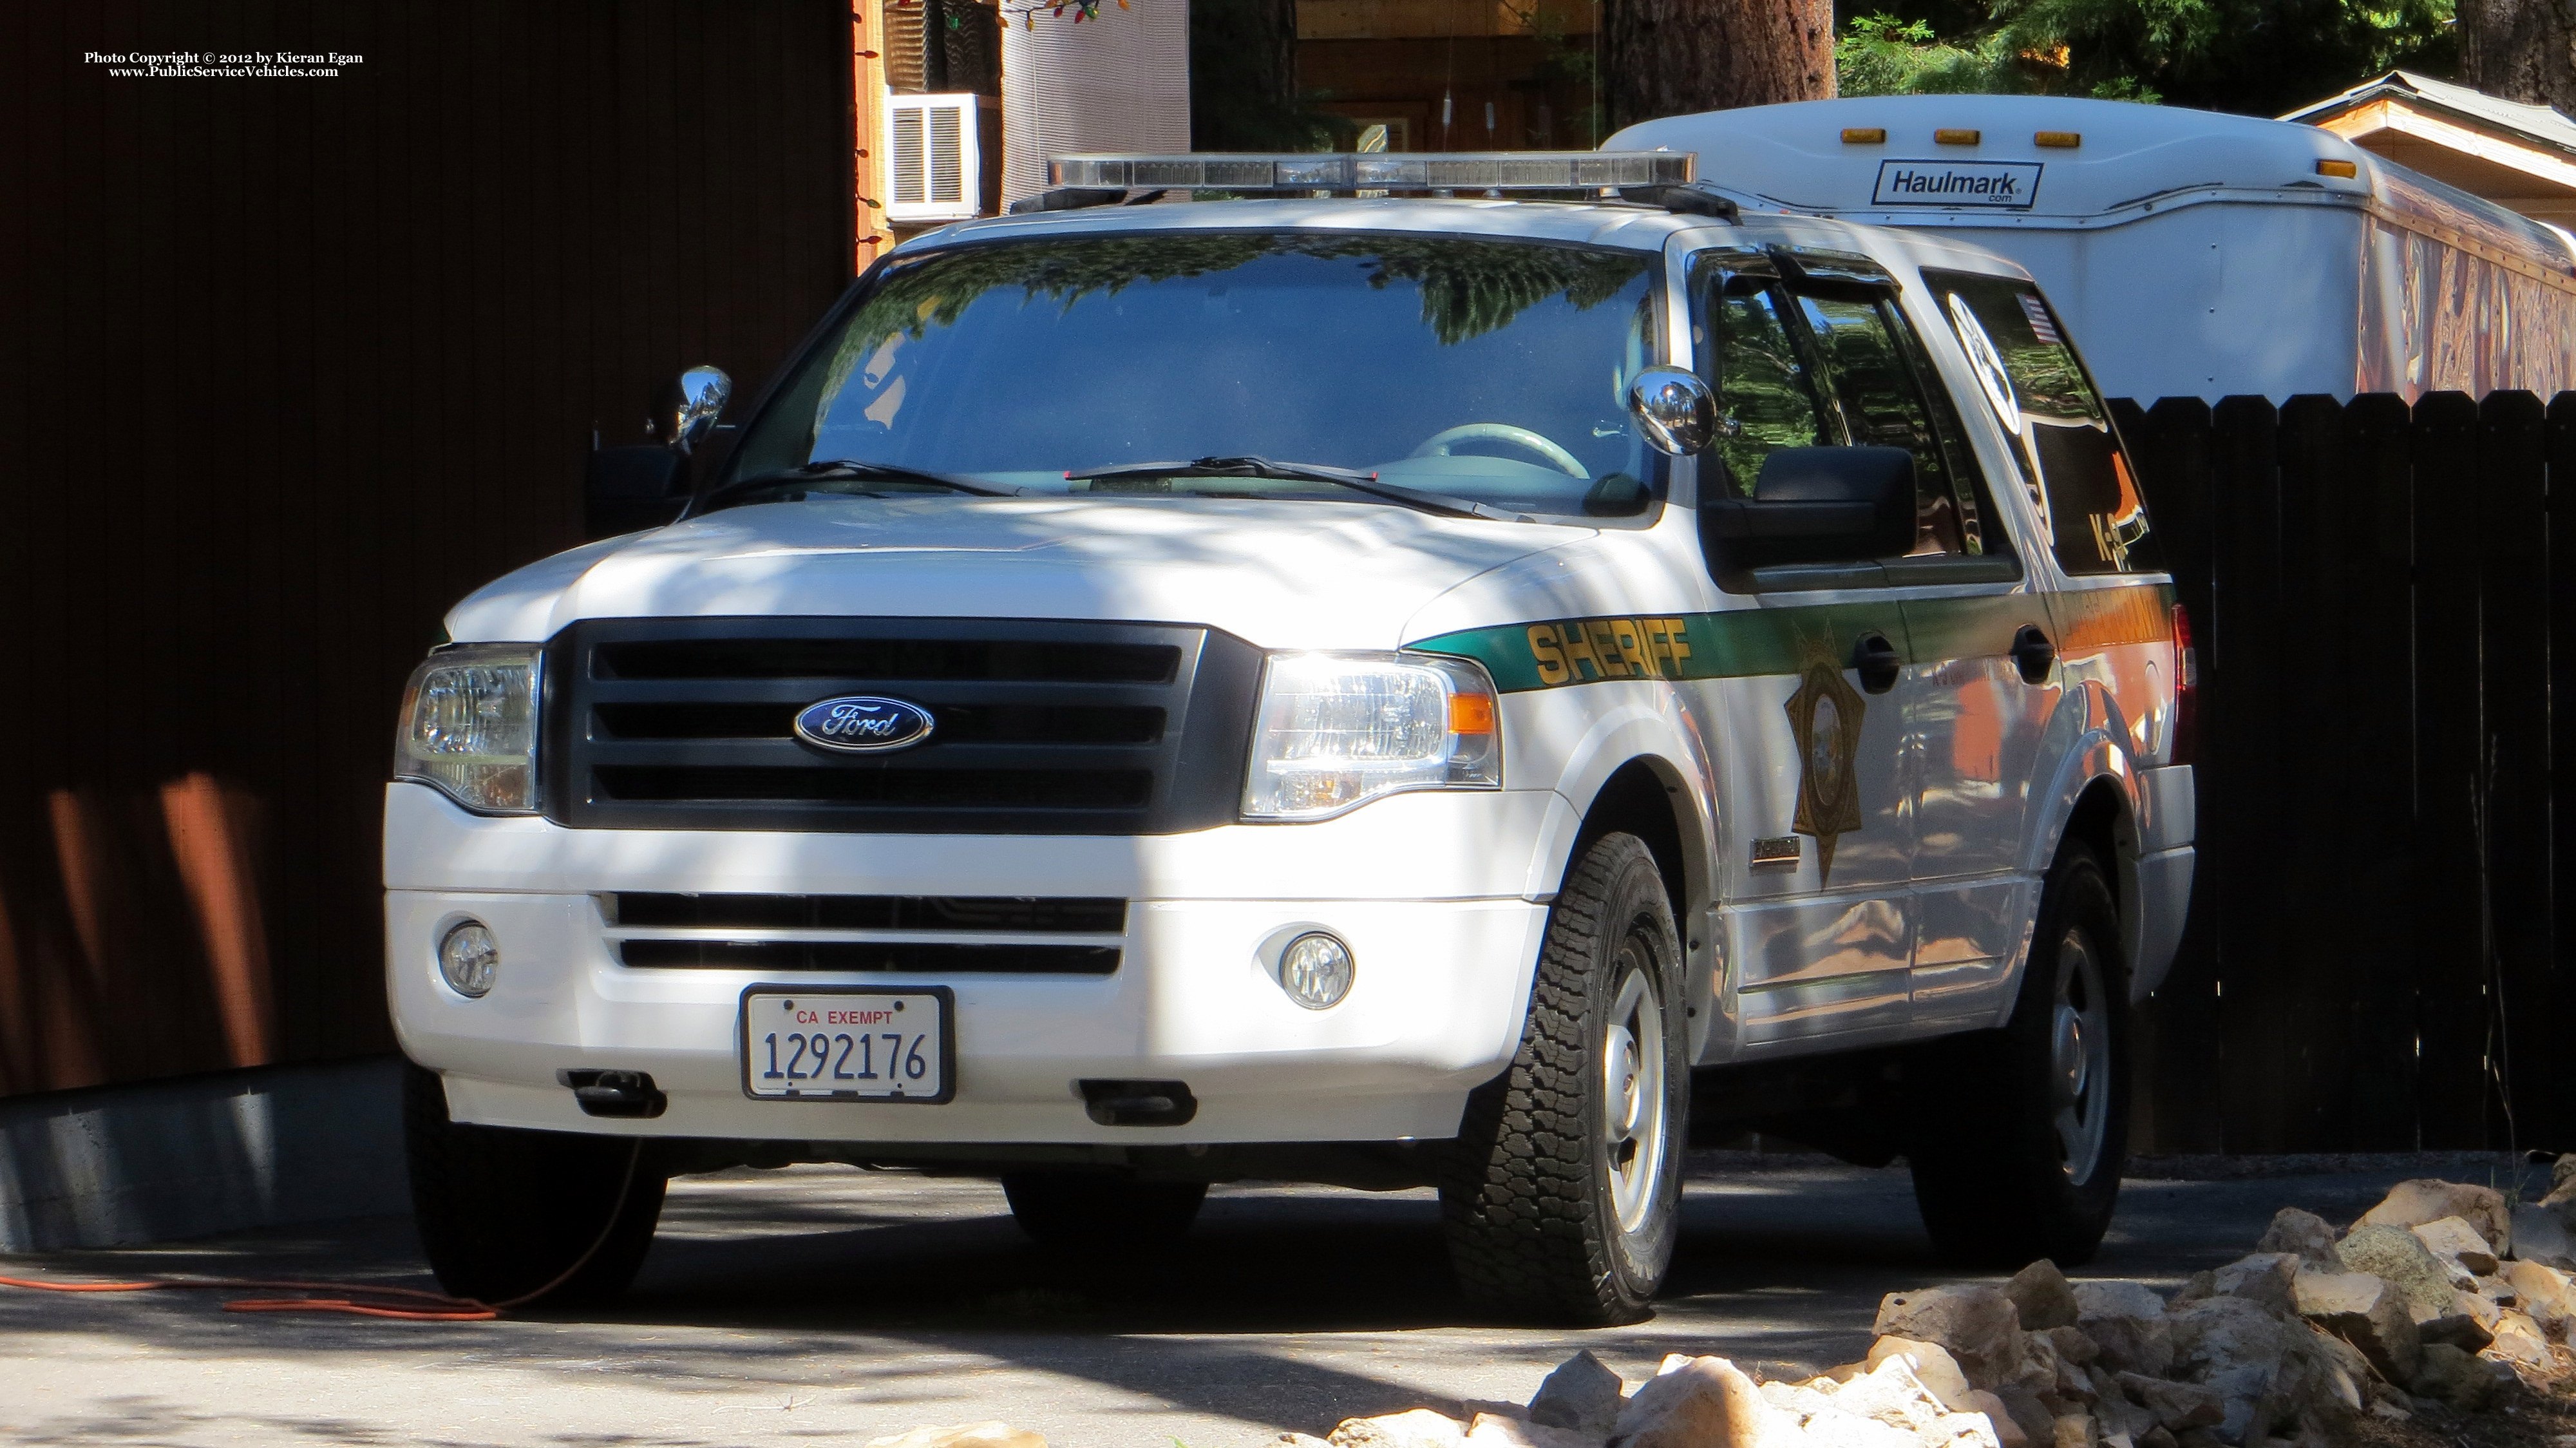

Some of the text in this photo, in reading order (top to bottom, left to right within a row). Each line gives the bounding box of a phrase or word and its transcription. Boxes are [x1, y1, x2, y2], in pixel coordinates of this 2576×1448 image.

[1527, 618, 1692, 685] SHERIFF
[822, 704, 899, 736] Ford
[797, 1011, 893, 1024] CA EXEMPT
[764, 1033, 926, 1079] 1292176
